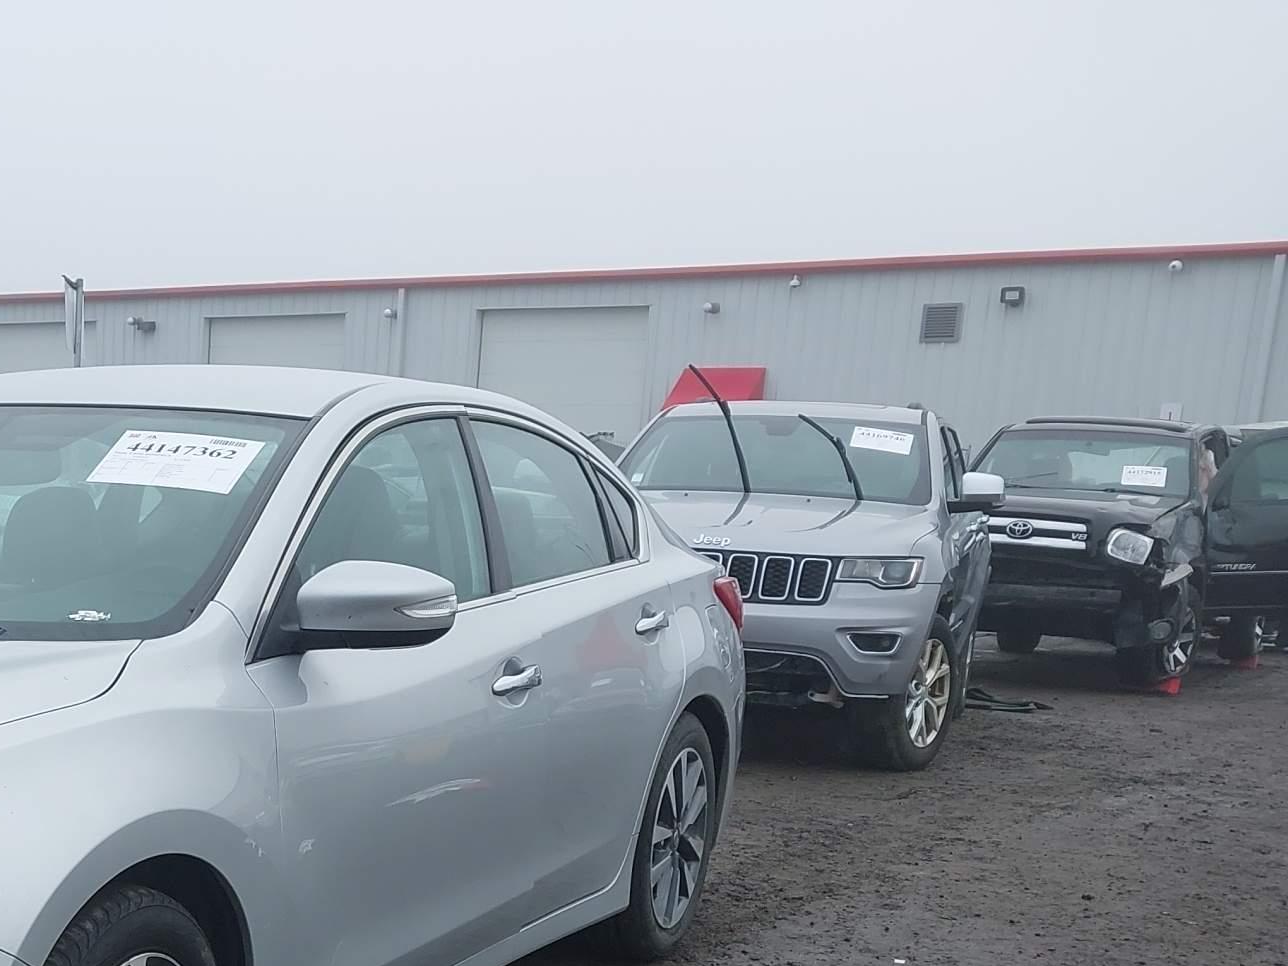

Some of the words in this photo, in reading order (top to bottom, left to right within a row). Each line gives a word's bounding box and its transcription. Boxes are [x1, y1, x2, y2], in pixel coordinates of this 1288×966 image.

[126, 441, 238, 460] 44147362
[693, 533, 731, 548] Jeep
[1071, 532, 1088, 541] V8
